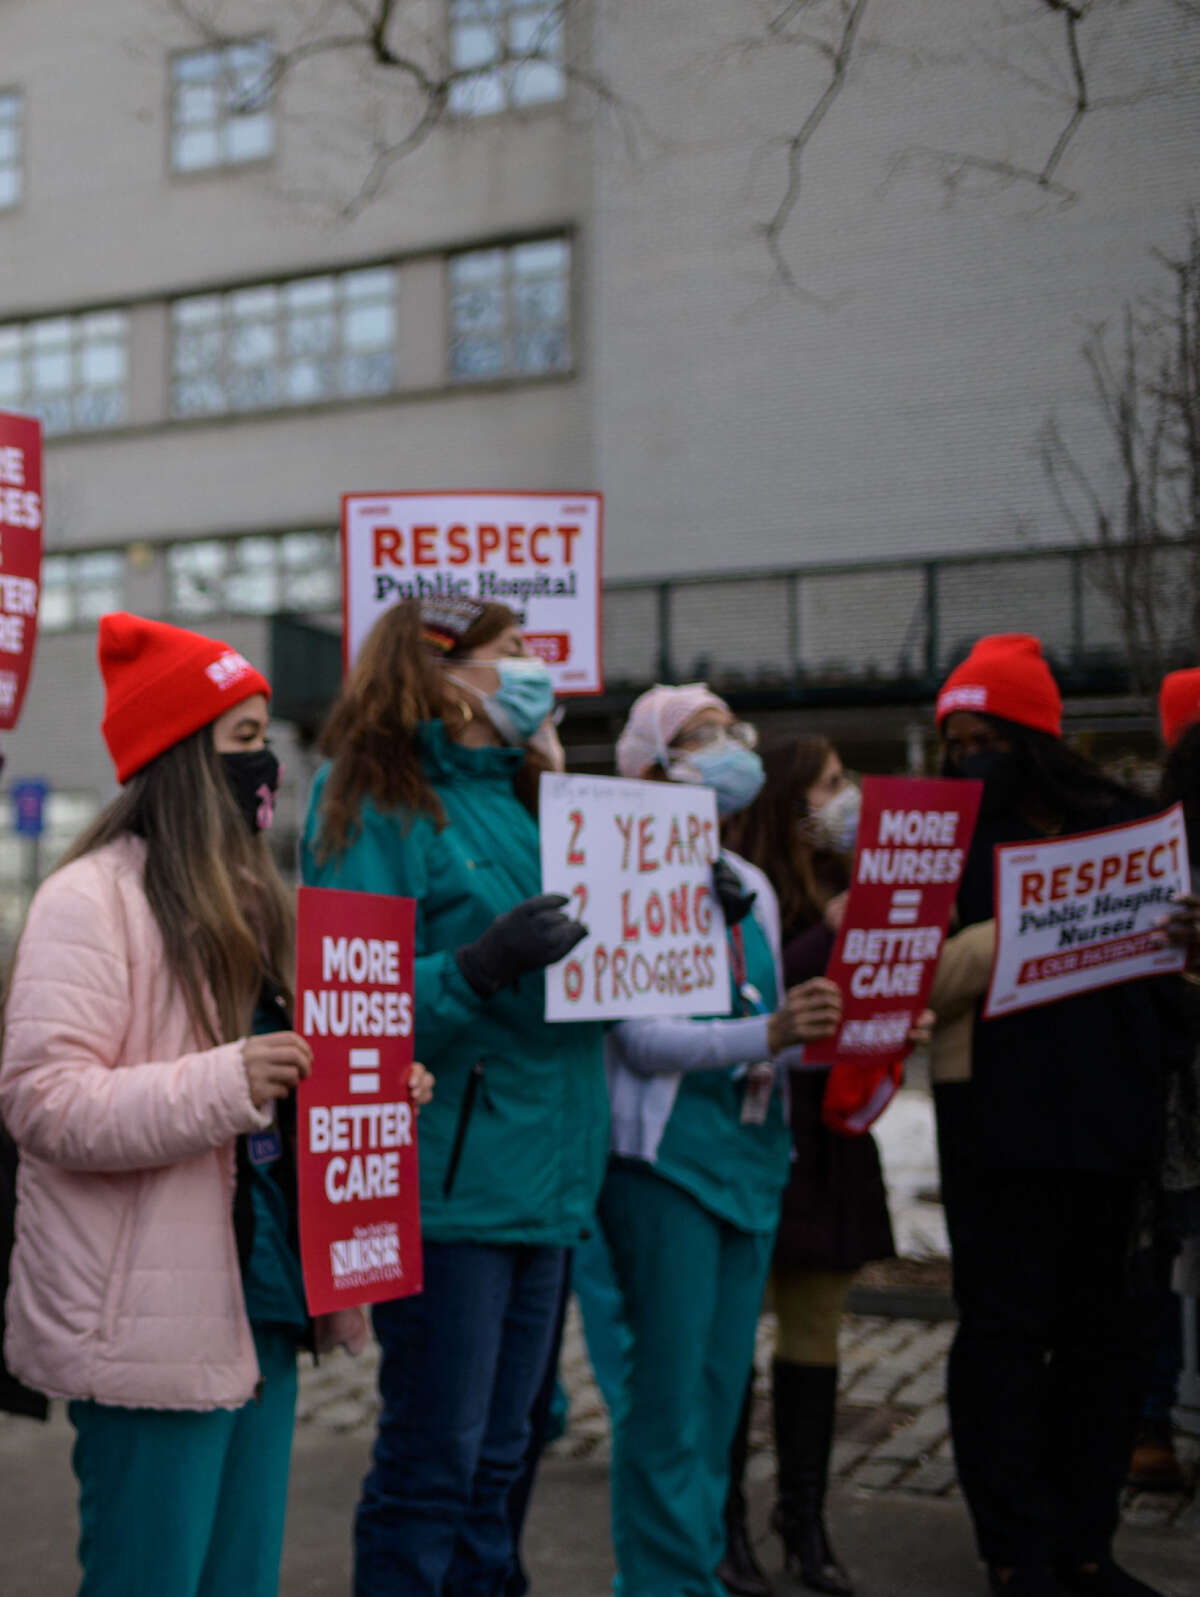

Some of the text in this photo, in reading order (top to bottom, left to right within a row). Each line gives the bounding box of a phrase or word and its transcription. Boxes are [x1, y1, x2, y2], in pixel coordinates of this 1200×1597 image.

[372, 524, 581, 568] RESPECT
[374, 570, 576, 602] Public Hospital
[567, 810, 714, 874] 2 YEARS
[878, 810, 959, 846] MORE
[857, 848, 963, 884] NURSES
[1020, 838, 1180, 908] RESPECT
[621, 884, 712, 942] LONG
[1019, 904, 1088, 936] Public
[1057, 916, 1135, 947] Nurses
[322, 936, 400, 985] MORE
[842, 926, 942, 963] BETTER
[593, 945, 715, 1005] PROGRESS
[851, 963, 924, 999] CARE
[303, 990, 412, 1037] NURSES
[309, 1101, 412, 1154] BETTER
[325, 1152, 400, 1204] CARE
